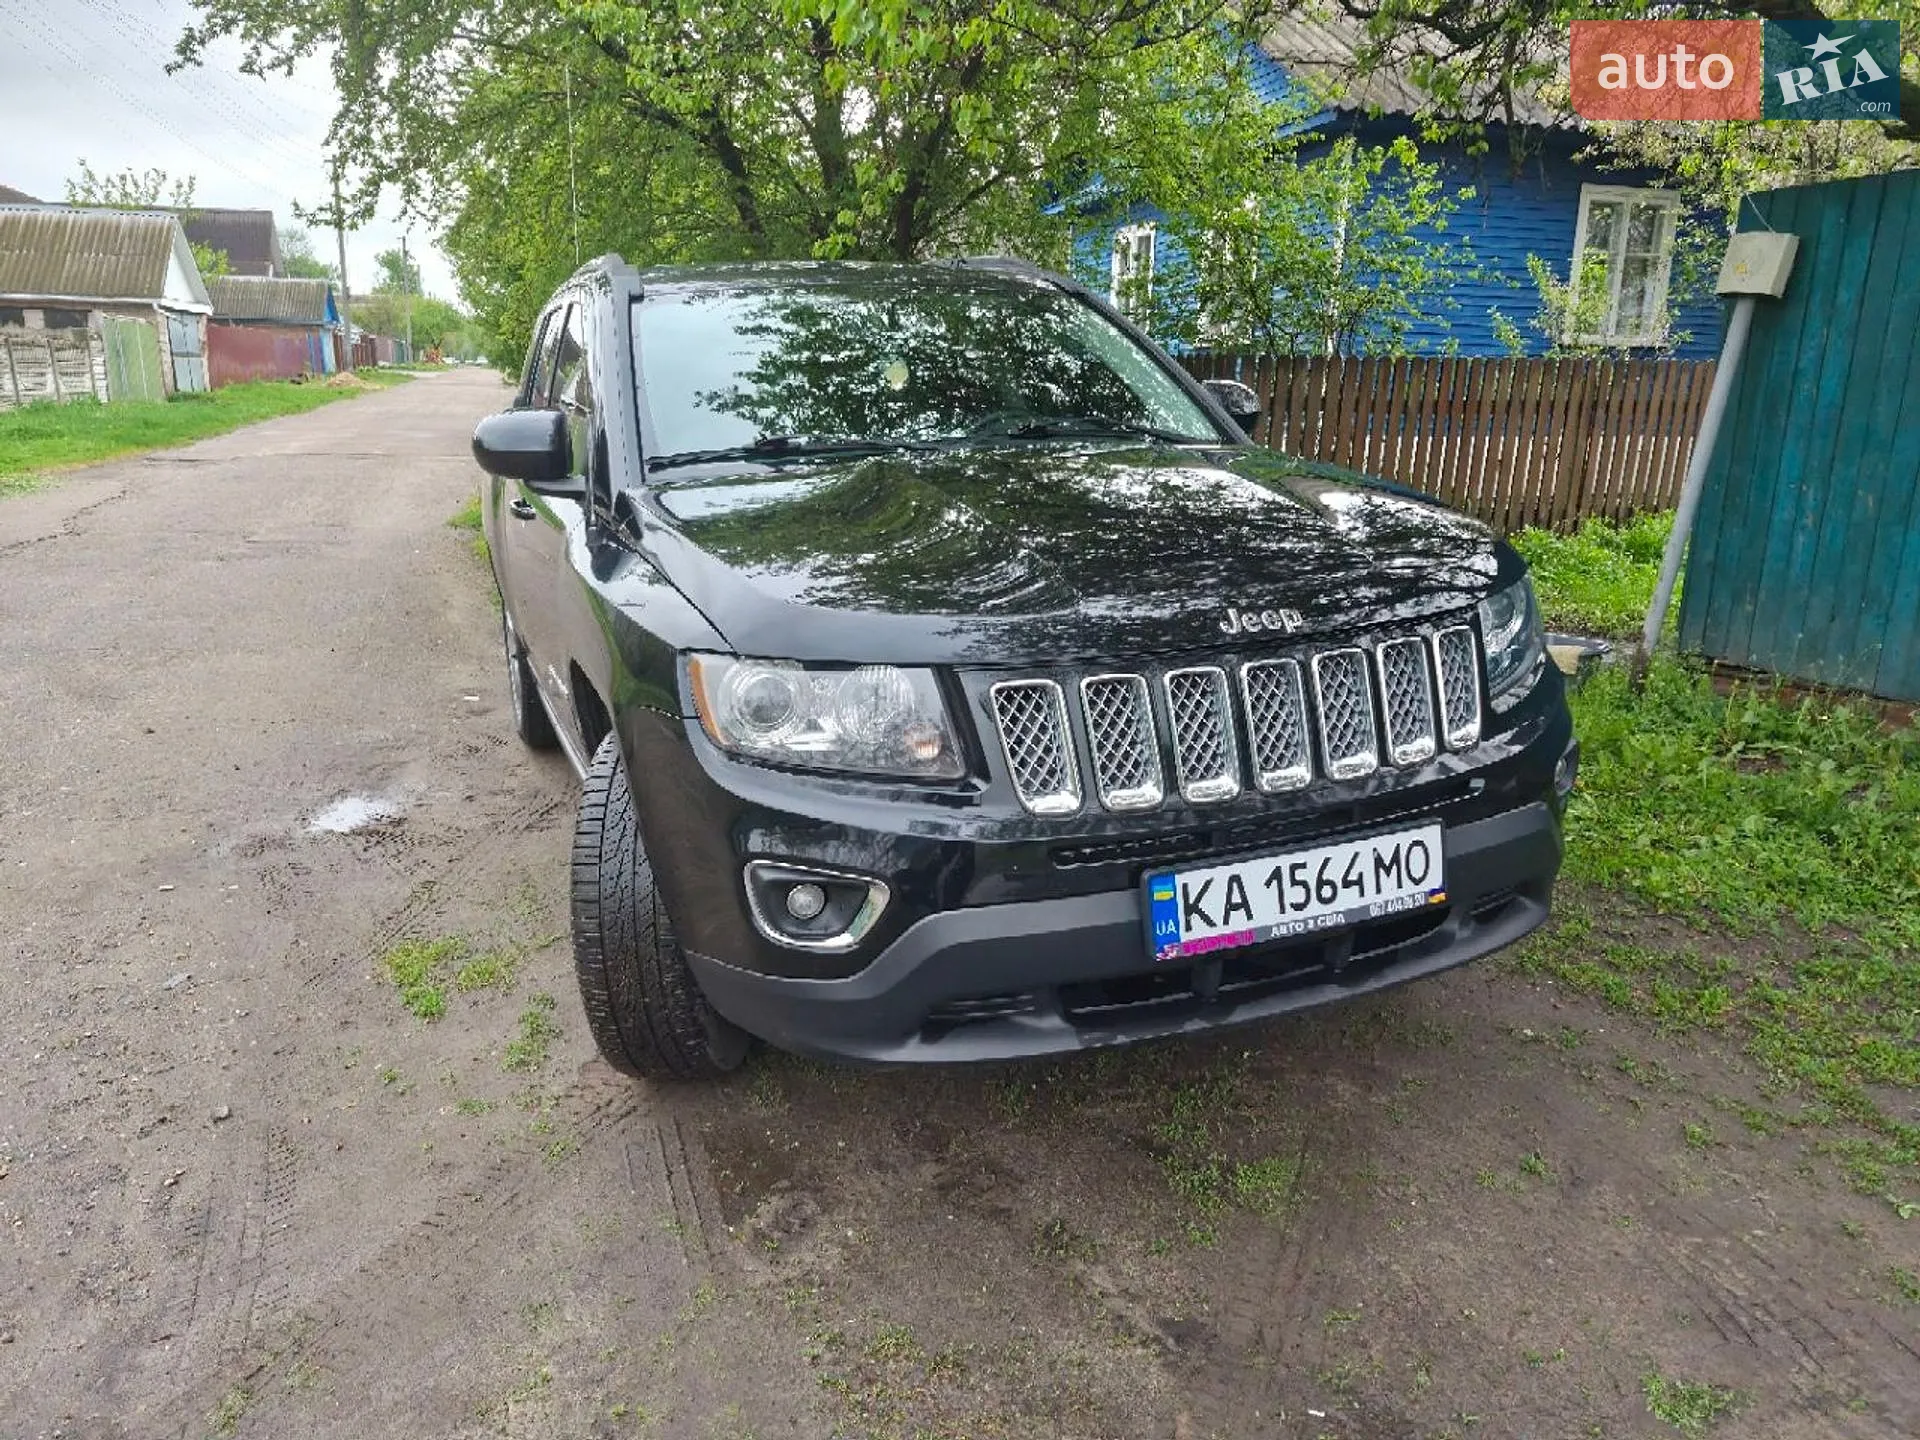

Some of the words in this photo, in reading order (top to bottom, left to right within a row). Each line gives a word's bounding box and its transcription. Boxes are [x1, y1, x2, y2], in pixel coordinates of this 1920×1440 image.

[1219, 608, 1303, 635] Jeep
[1181, 874, 1254, 932] KA
[1264, 851, 1365, 914] 1564
[1372, 839, 1430, 895] MO
[1156, 919, 1178, 936] UA
